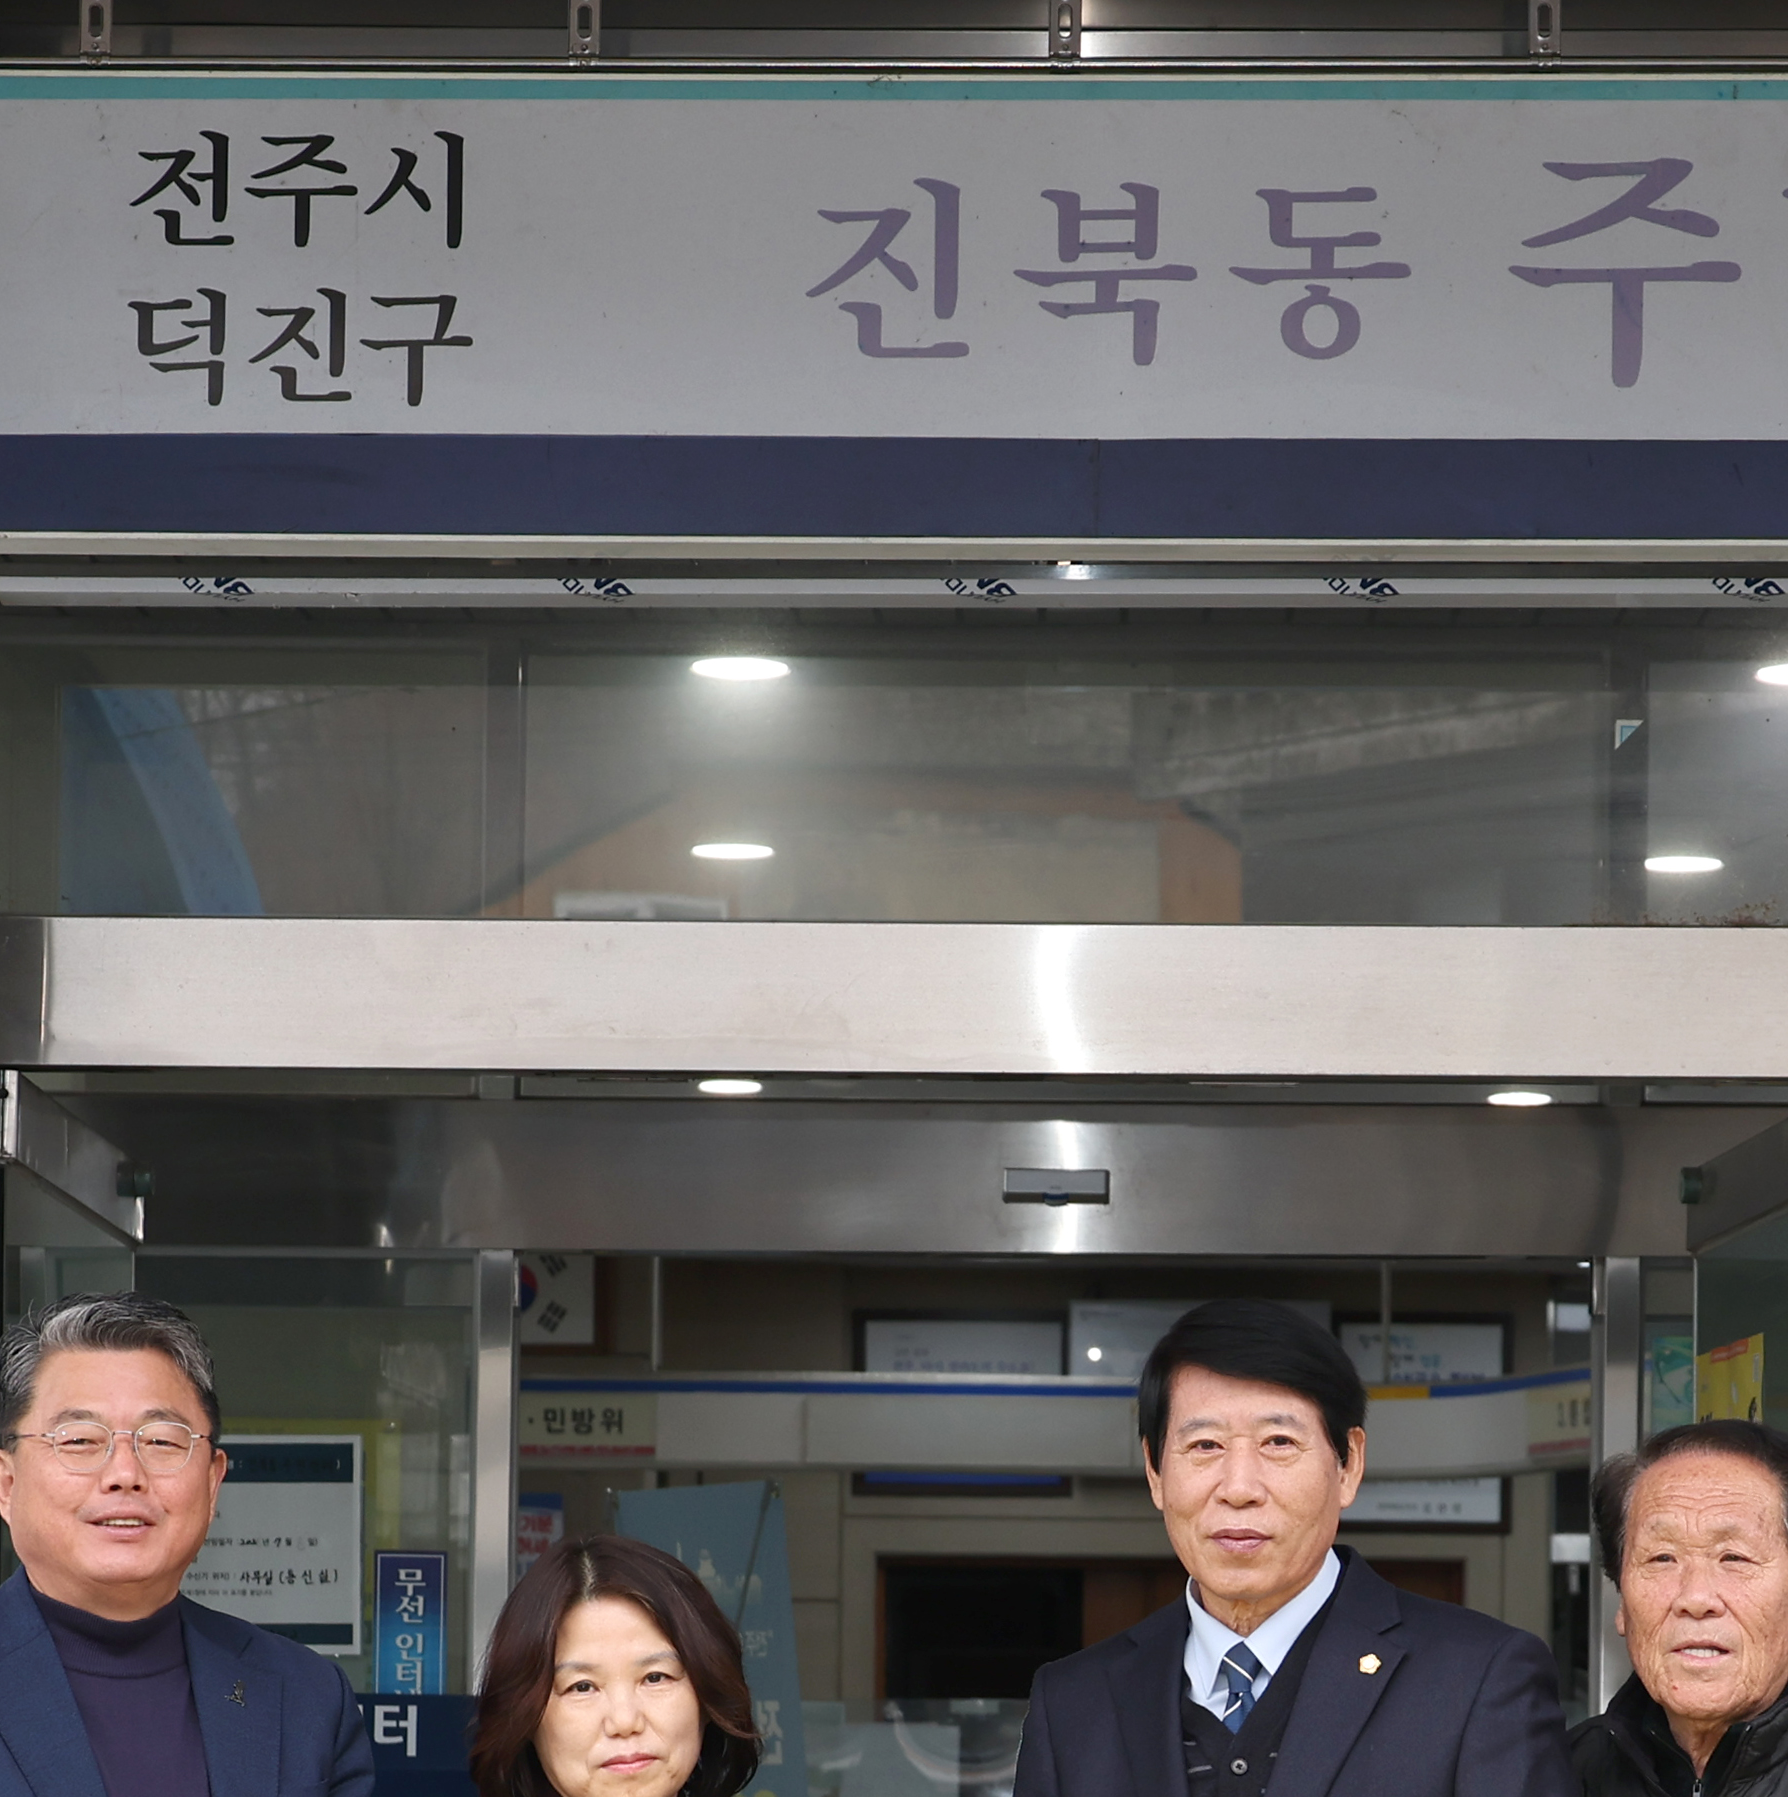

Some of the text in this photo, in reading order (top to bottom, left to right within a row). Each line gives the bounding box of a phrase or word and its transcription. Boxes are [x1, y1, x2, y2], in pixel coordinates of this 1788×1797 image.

[130, 131, 463, 248] 전주시
[806, 178, 1411, 365] 진북동
[128, 288, 473, 406] 덕진구
[542, 1406, 625, 1434] 민방위
[394, 1568, 427, 1624] 무선
[394, 1632, 425, 1696] 인터
